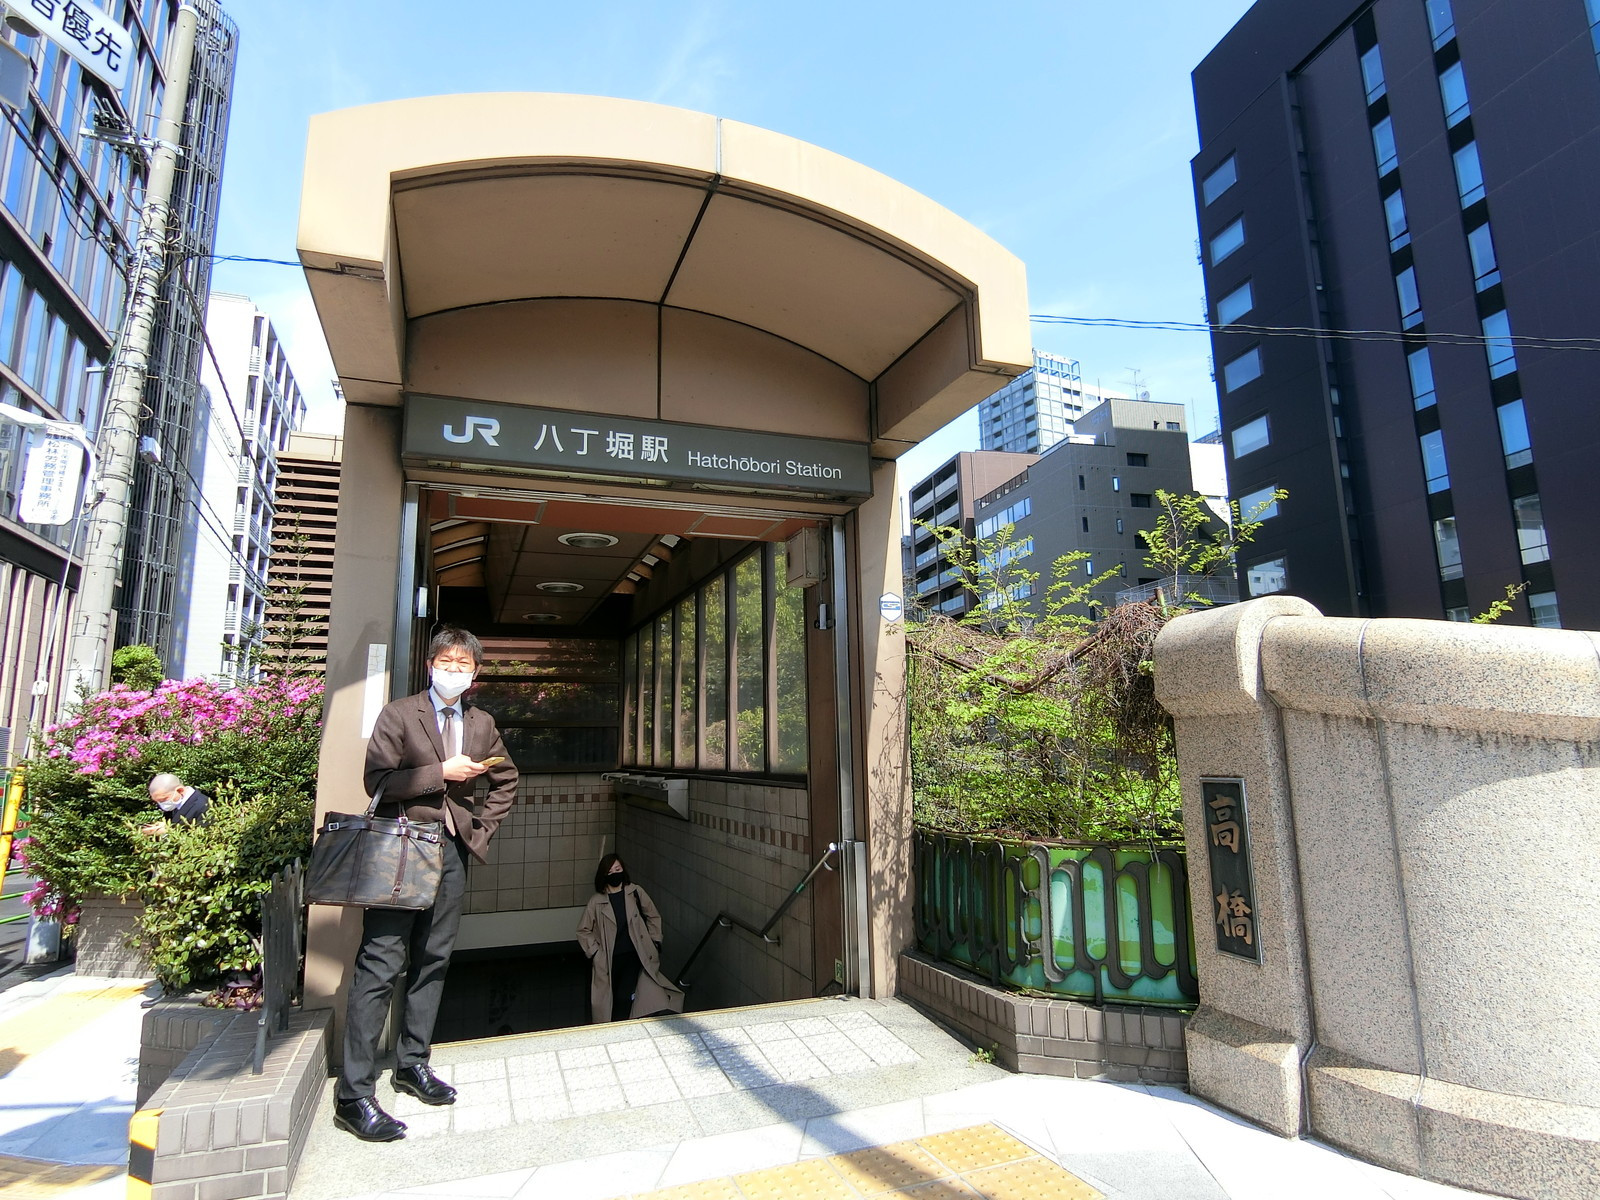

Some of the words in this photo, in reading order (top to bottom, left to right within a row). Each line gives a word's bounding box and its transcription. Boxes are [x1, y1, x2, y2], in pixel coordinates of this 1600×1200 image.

[443, 415, 500, 447] JR
[533, 424, 669, 463] 八丁堀駅
[688, 450, 780, 474] Hatchōbori
[785, 460, 842, 479] Station
[1208, 794, 1252, 945] 高橋
